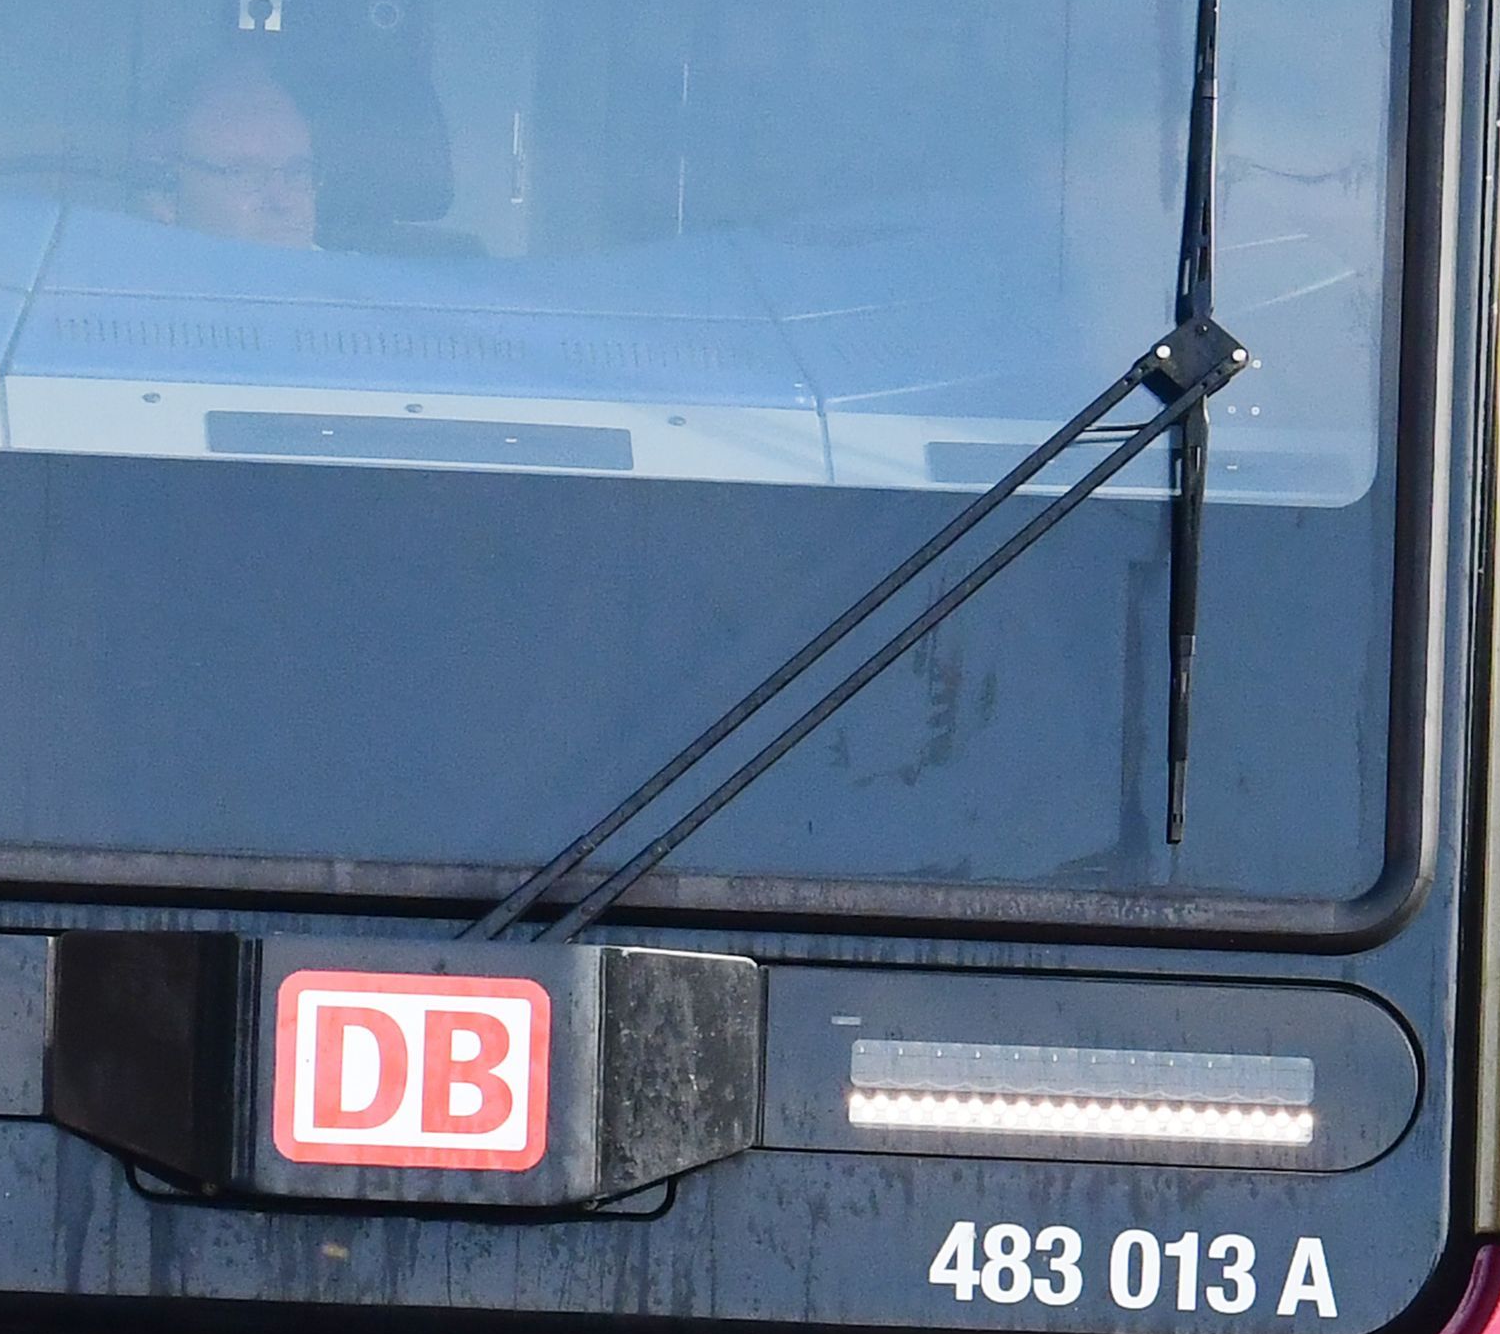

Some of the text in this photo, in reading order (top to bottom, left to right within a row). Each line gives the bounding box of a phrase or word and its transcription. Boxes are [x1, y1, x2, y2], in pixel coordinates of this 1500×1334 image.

[311, 1004, 514, 1139] DB
[928, 1221, 1338, 1318] 483 013 A
